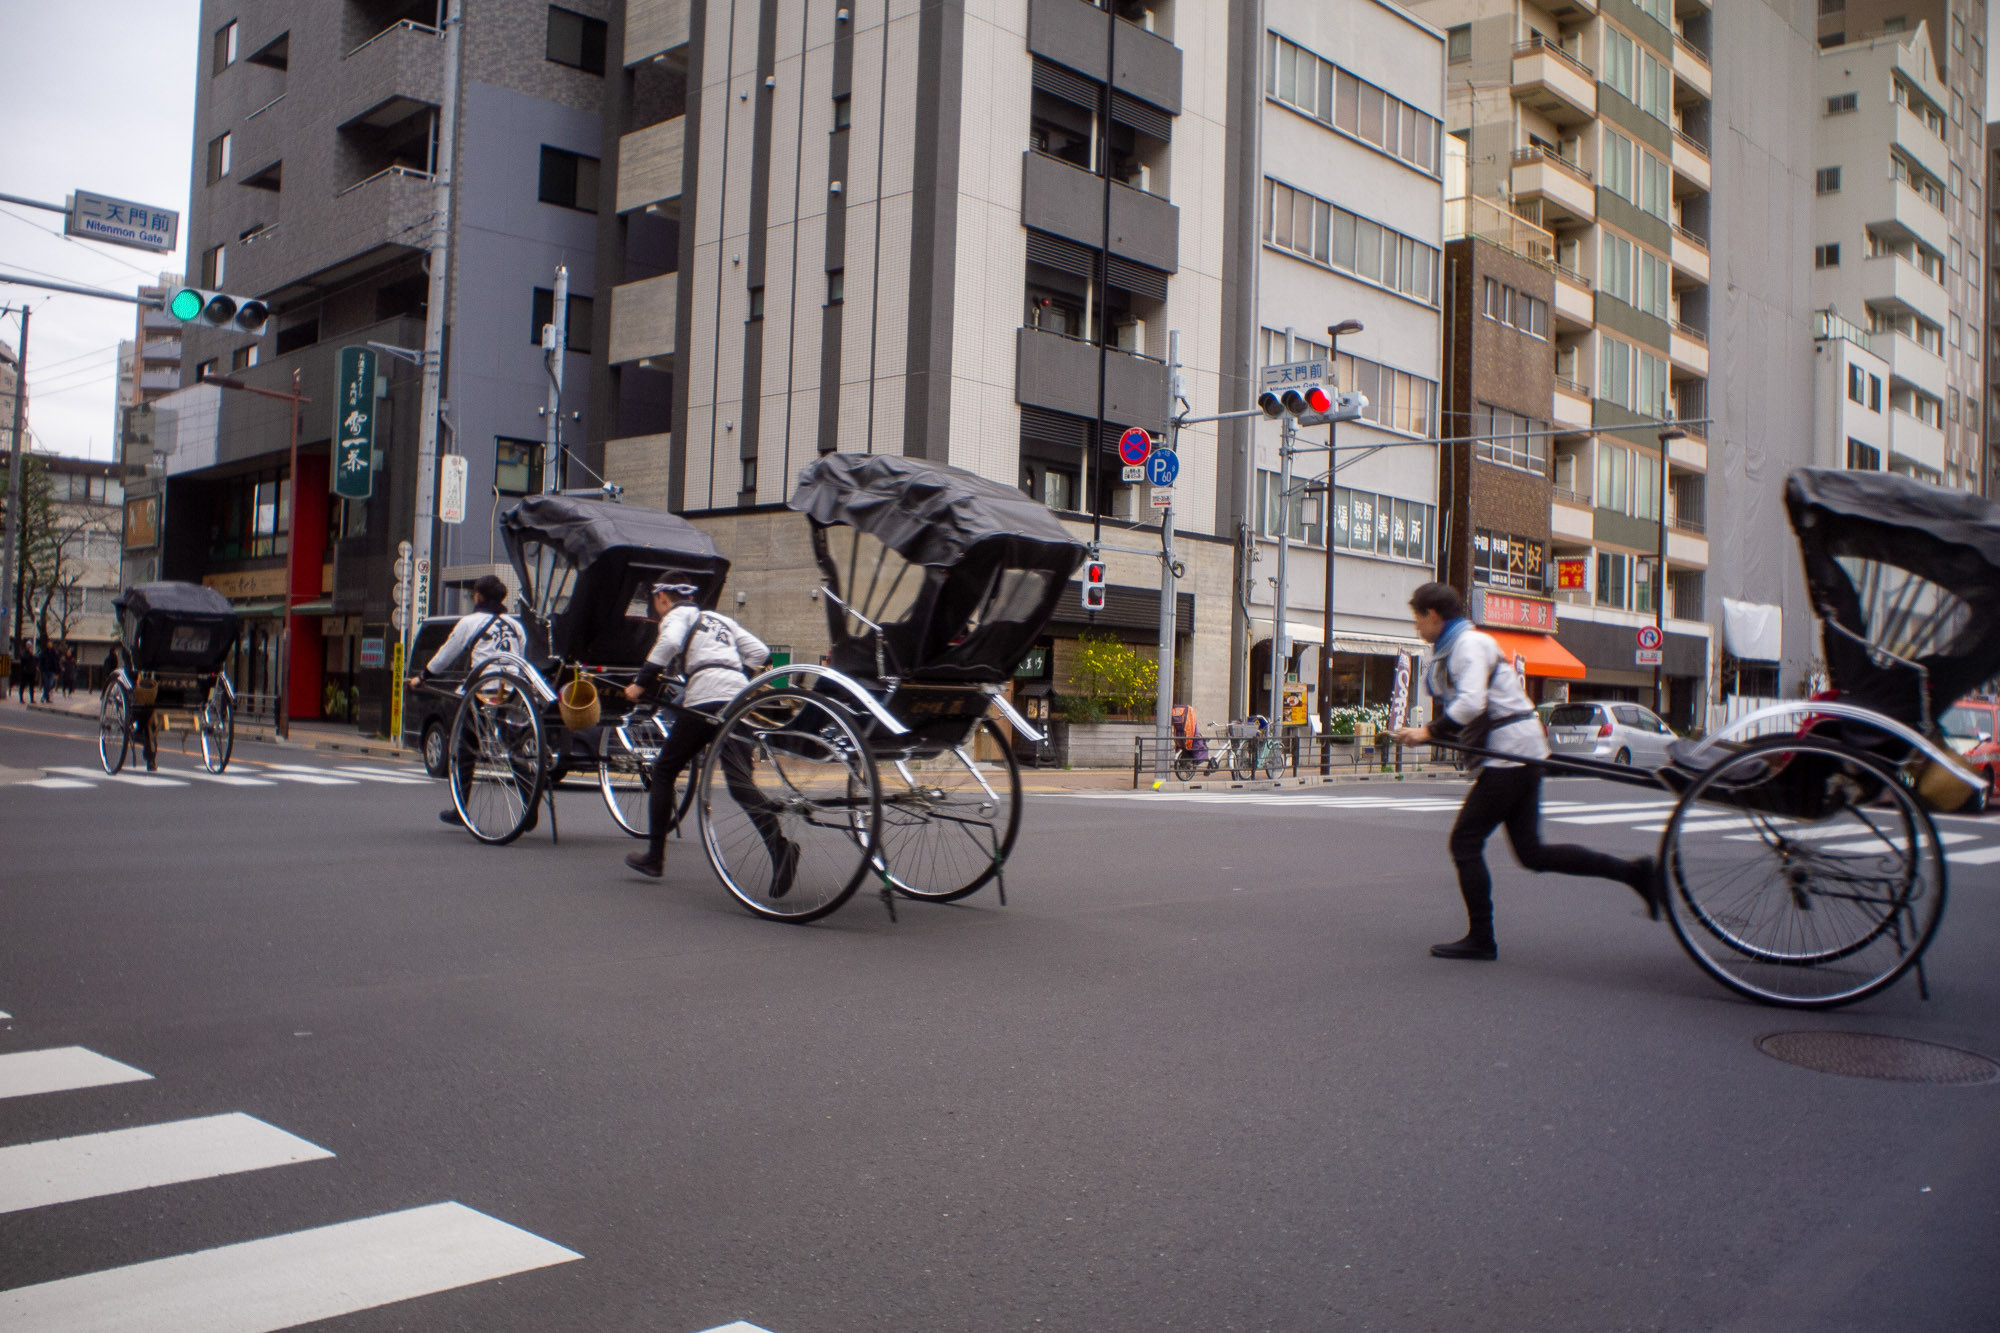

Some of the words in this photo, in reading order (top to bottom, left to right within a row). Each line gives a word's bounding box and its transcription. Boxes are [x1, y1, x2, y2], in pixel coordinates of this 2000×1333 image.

[82, 198, 169, 233] 二天門前
[86, 218, 136, 239] Nitenmon
[139, 230, 164, 244] Gate
[1266, 363, 1323, 384] 二天門前
[1153, 458, 1167, 482] P
[1162, 471, 1172, 482] 60
[1510, 541, 1542, 573] 天好
[1559, 563, 1584, 575] ラーメン
[1520, 601, 1548, 626] 天好
